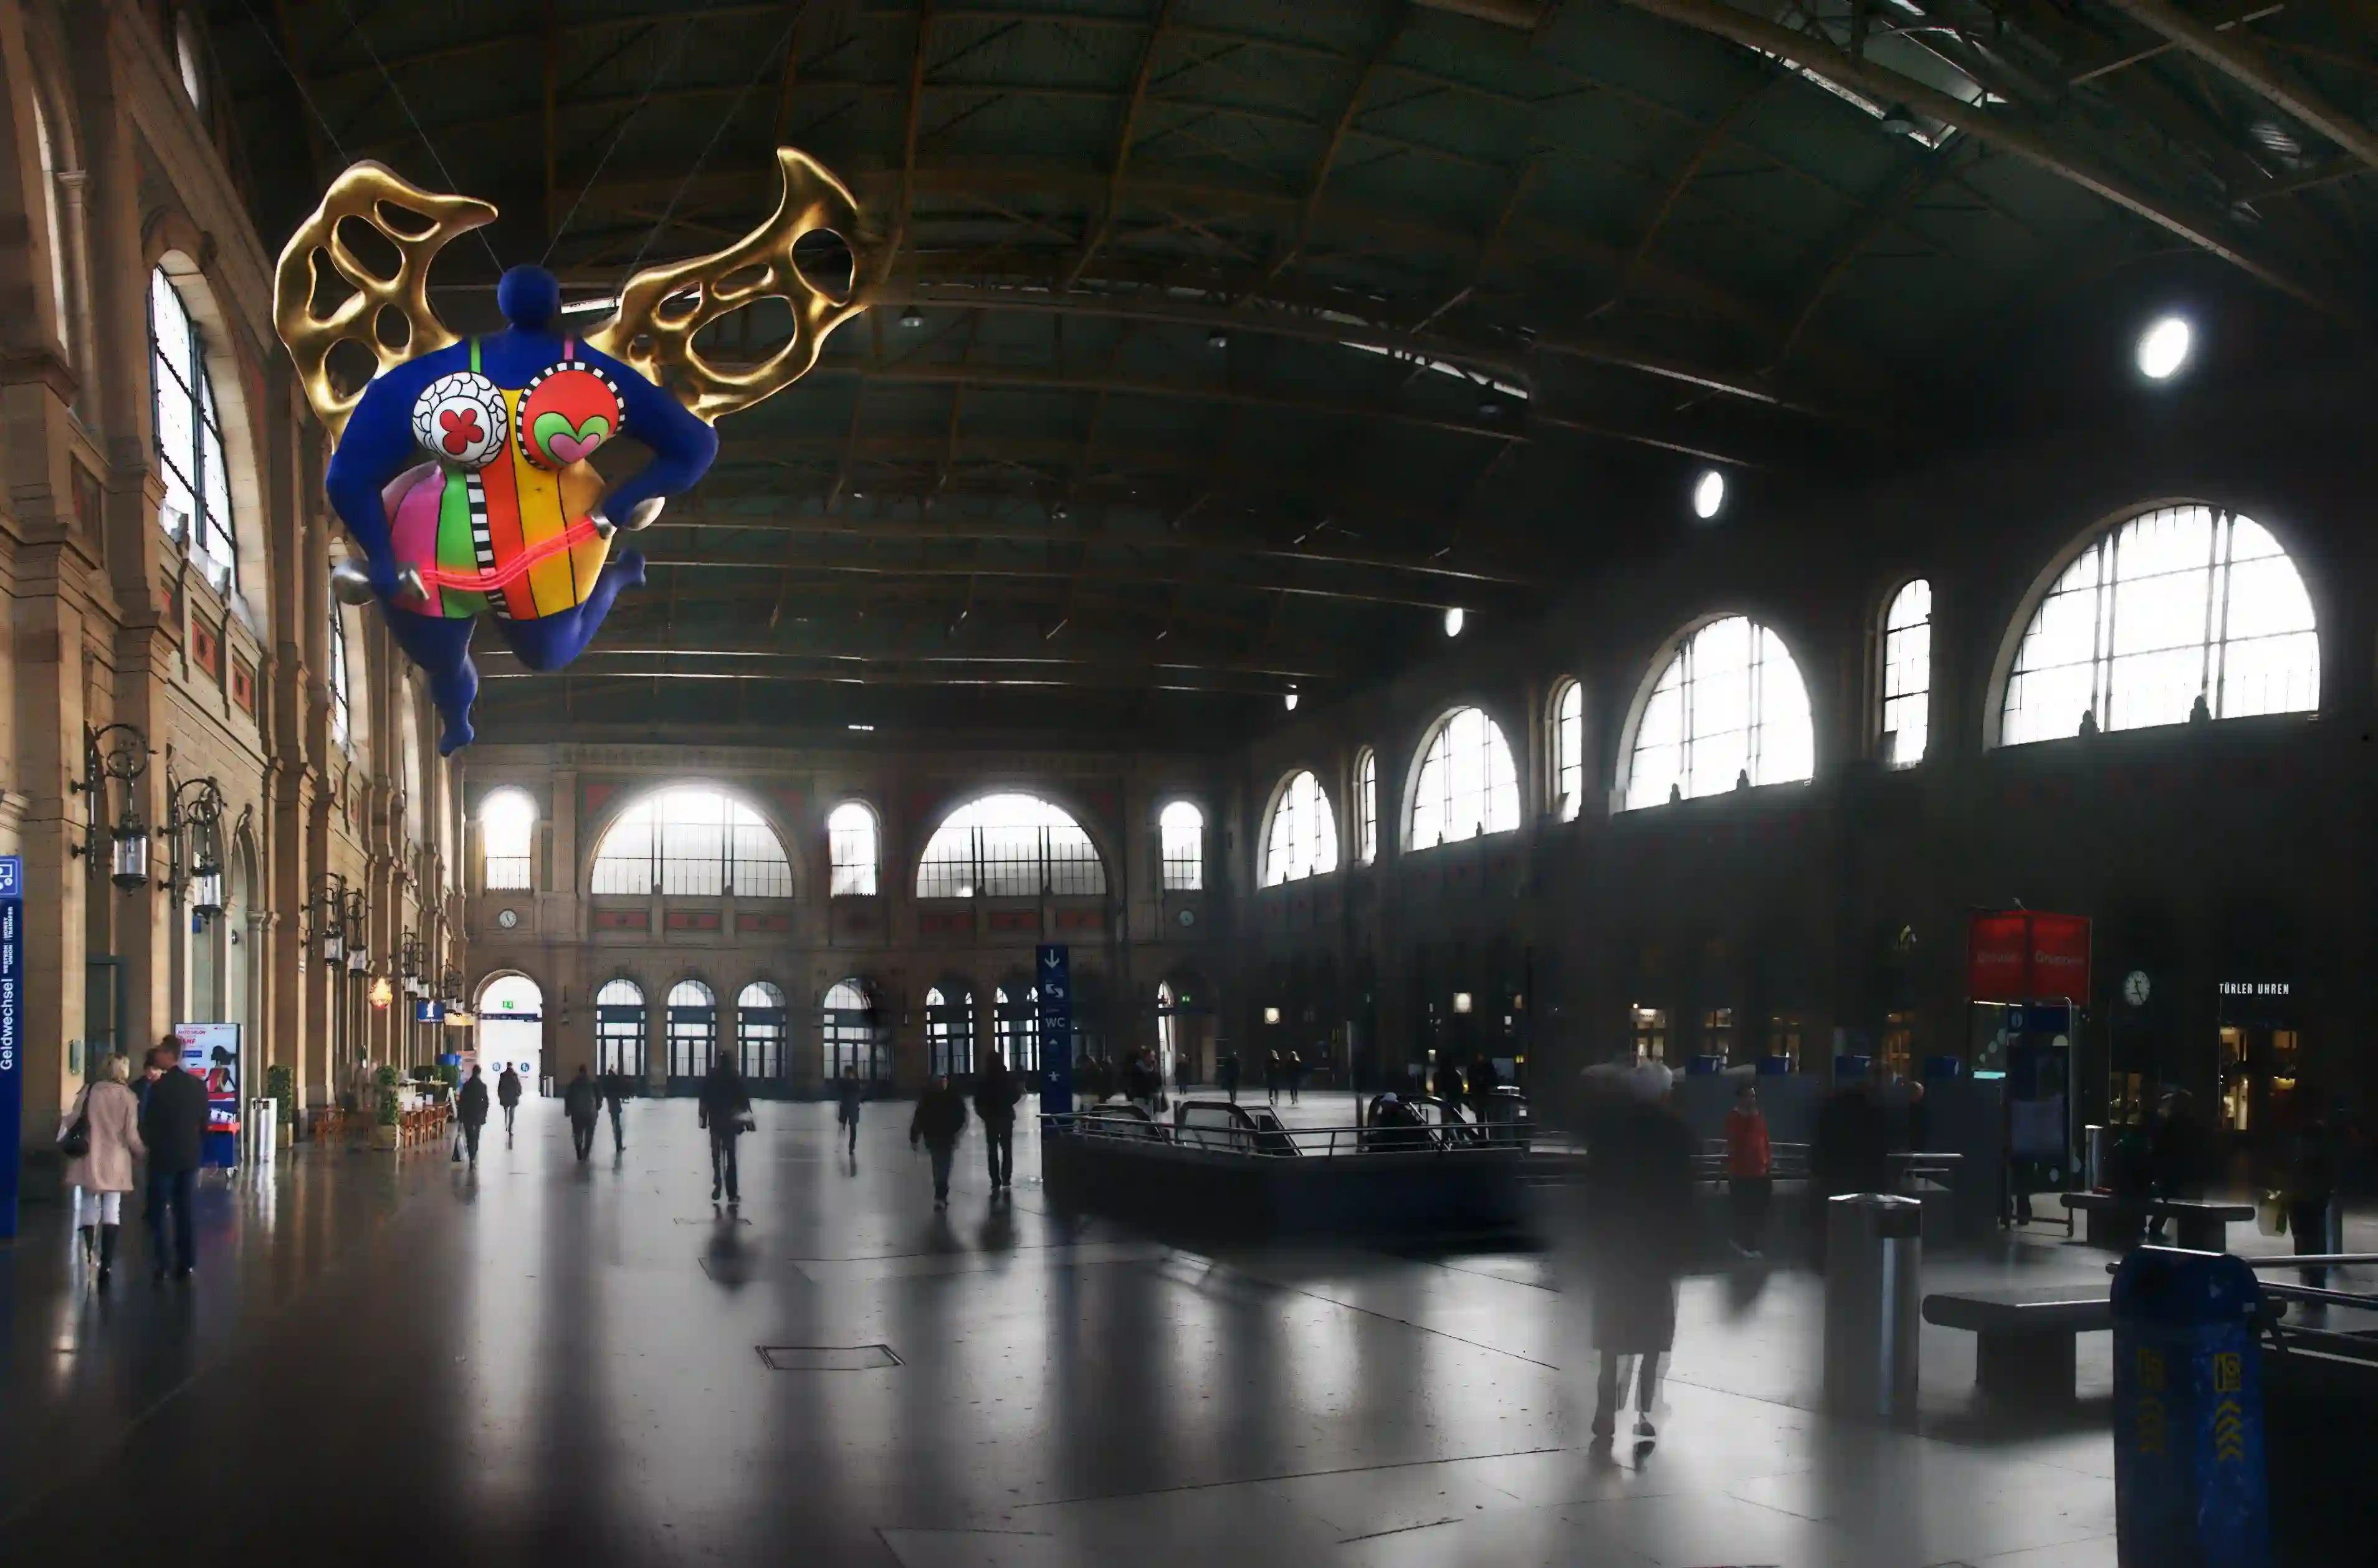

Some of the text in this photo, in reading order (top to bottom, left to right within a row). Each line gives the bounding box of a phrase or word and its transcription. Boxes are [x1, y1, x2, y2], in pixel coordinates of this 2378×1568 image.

[2218, 982, 2290, 995] TÜRLER UHREN
[0, 978, 14, 1070] Geldwechsel
[1045, 1016, 1065, 1029] WC
